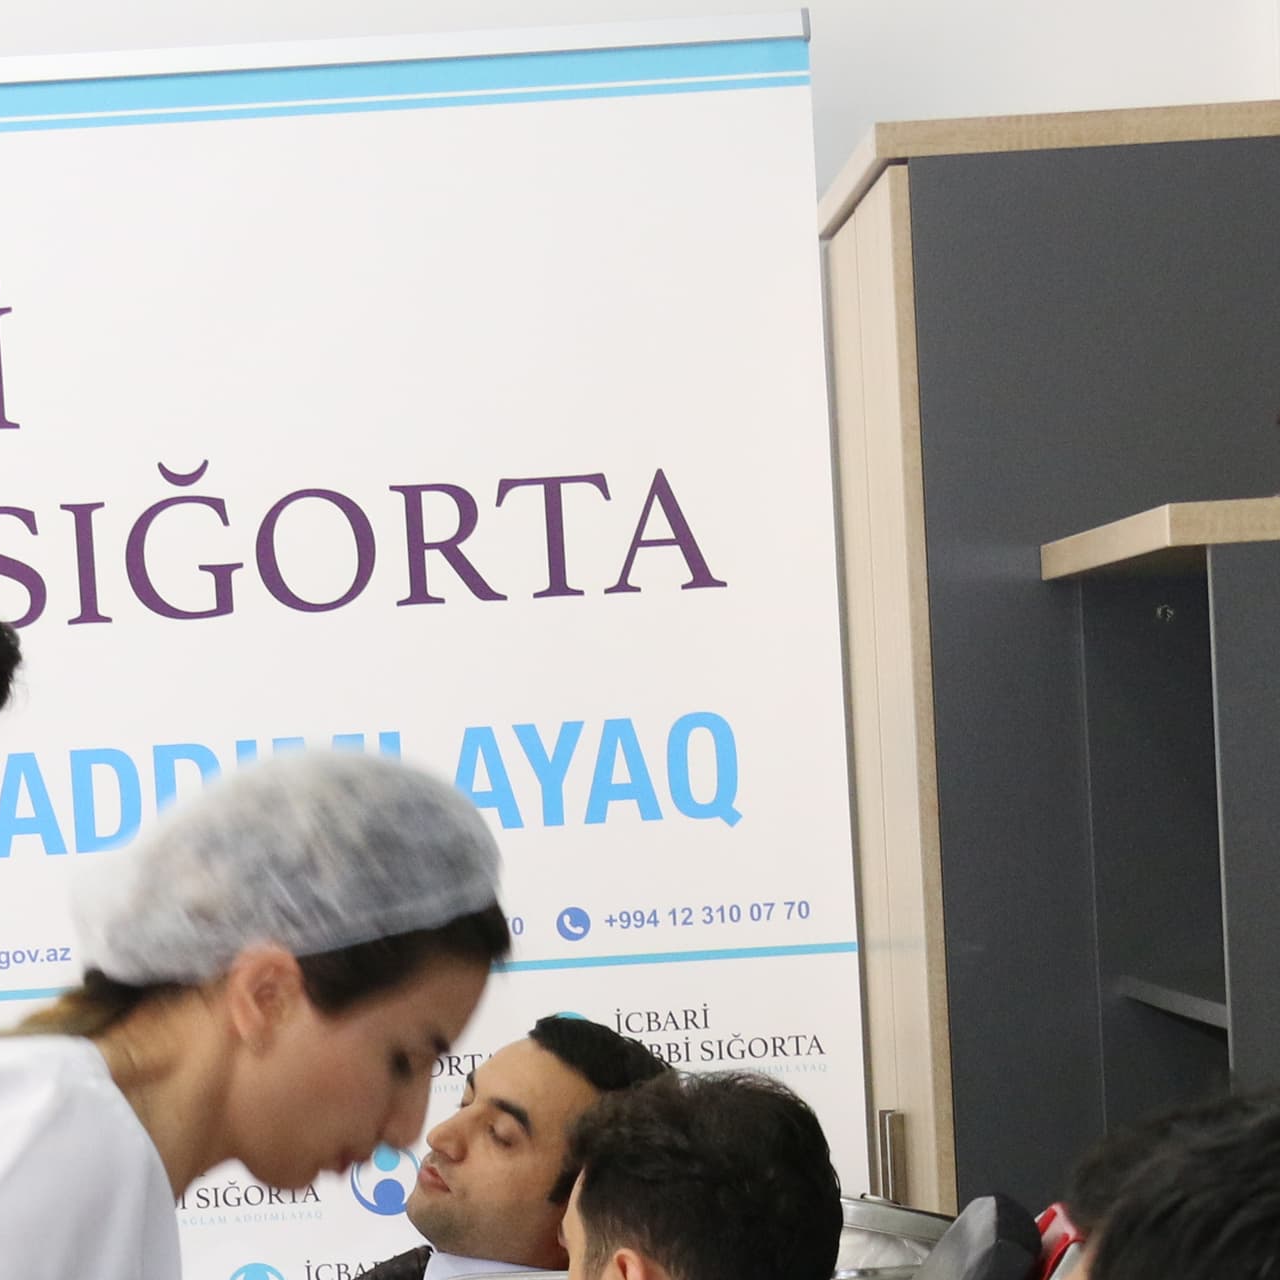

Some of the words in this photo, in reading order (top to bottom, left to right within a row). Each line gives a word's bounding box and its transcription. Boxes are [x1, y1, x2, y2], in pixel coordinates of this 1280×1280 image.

[604, 909, 660, 930] +994
[668, 907, 693, 927] 12
[702, 904, 742, 924] 310
[750, 902, 775, 922] 07
[784, 900, 811, 920] 70
[614, 1003, 710, 1035] İCBARİ
[647, 1036, 691, 1063] BBİ
[701, 1033, 825, 1062] SIĞORTA
